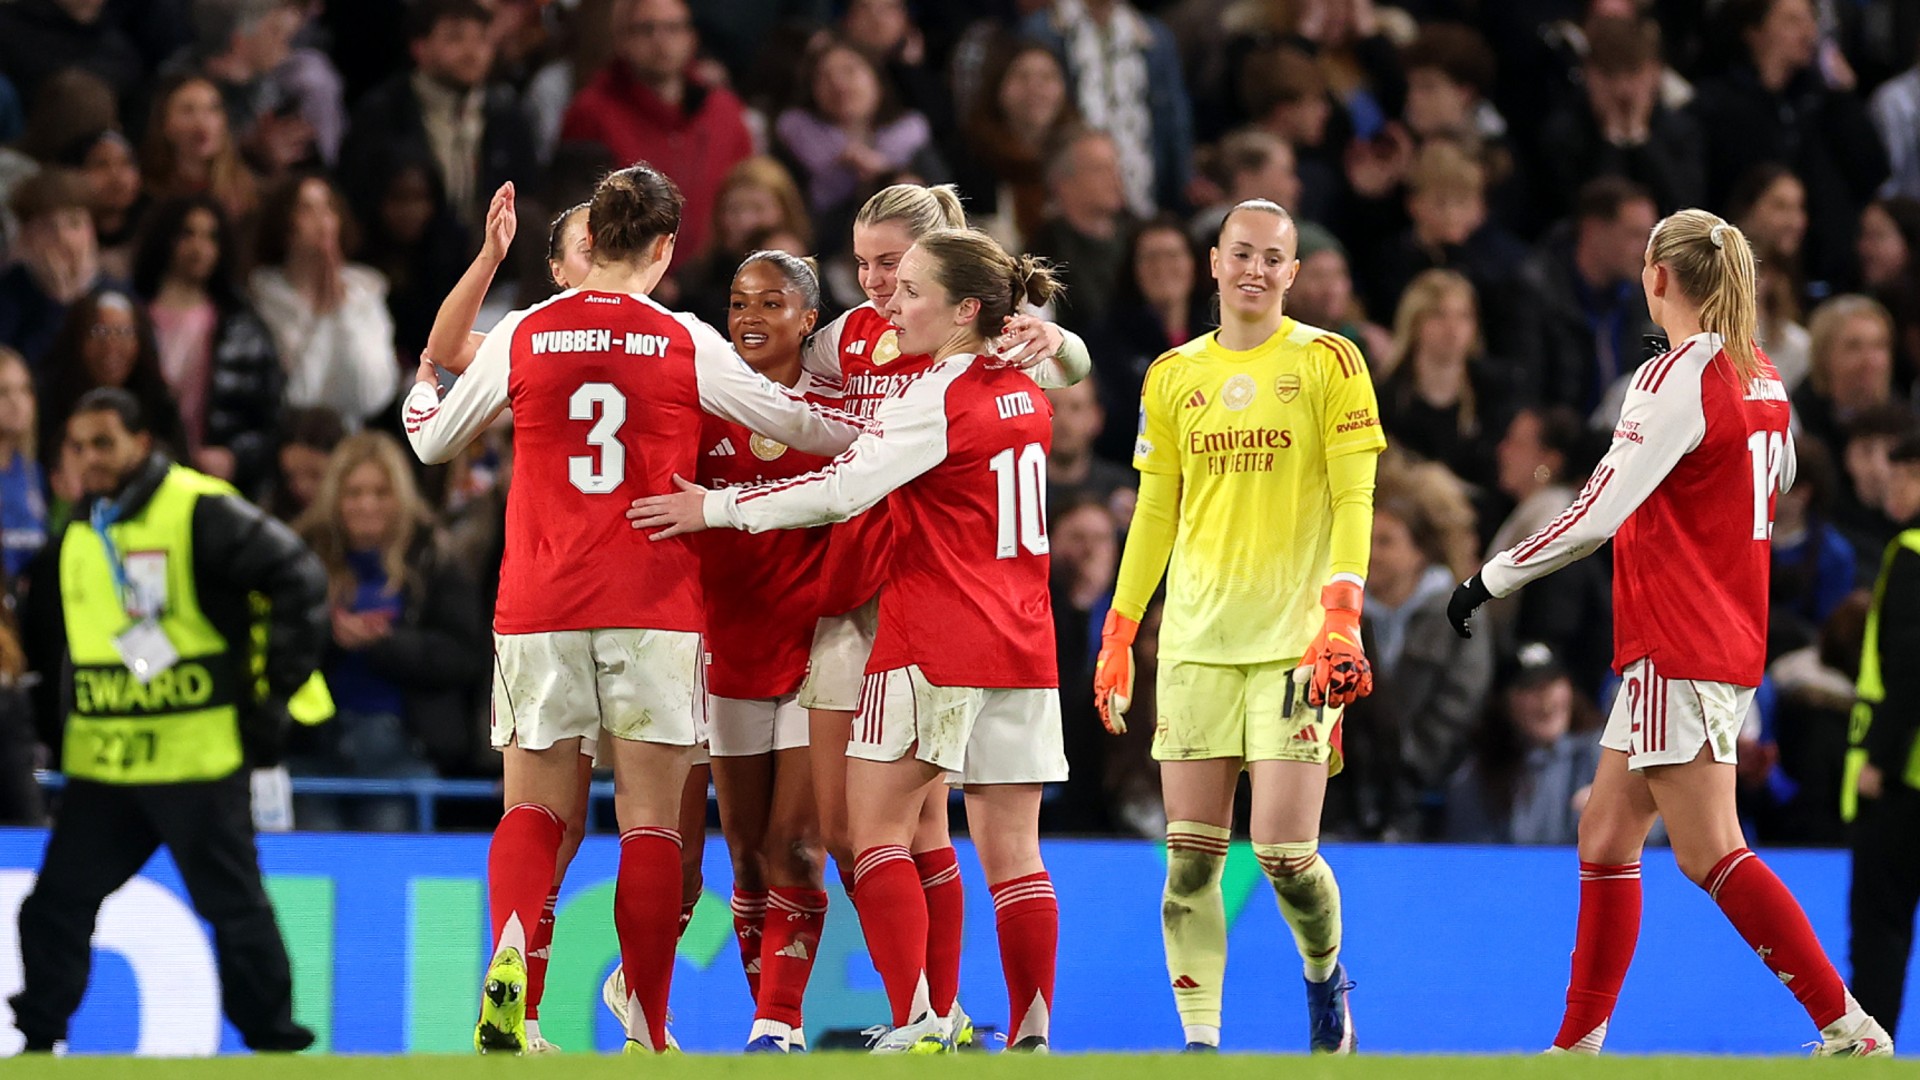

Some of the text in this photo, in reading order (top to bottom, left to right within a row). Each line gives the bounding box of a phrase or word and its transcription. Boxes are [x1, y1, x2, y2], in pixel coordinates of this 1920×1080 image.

[584, 294, 621, 305] Arsenal
[995, 391, 1036, 419] LITTLE
[1344, 408, 1369, 421] VISIT
[568, 381, 627, 494] 3
[1190, 425, 1292, 455] Emirates
[1208, 454, 1226, 476] FLY
[988, 442, 1050, 560] 10
